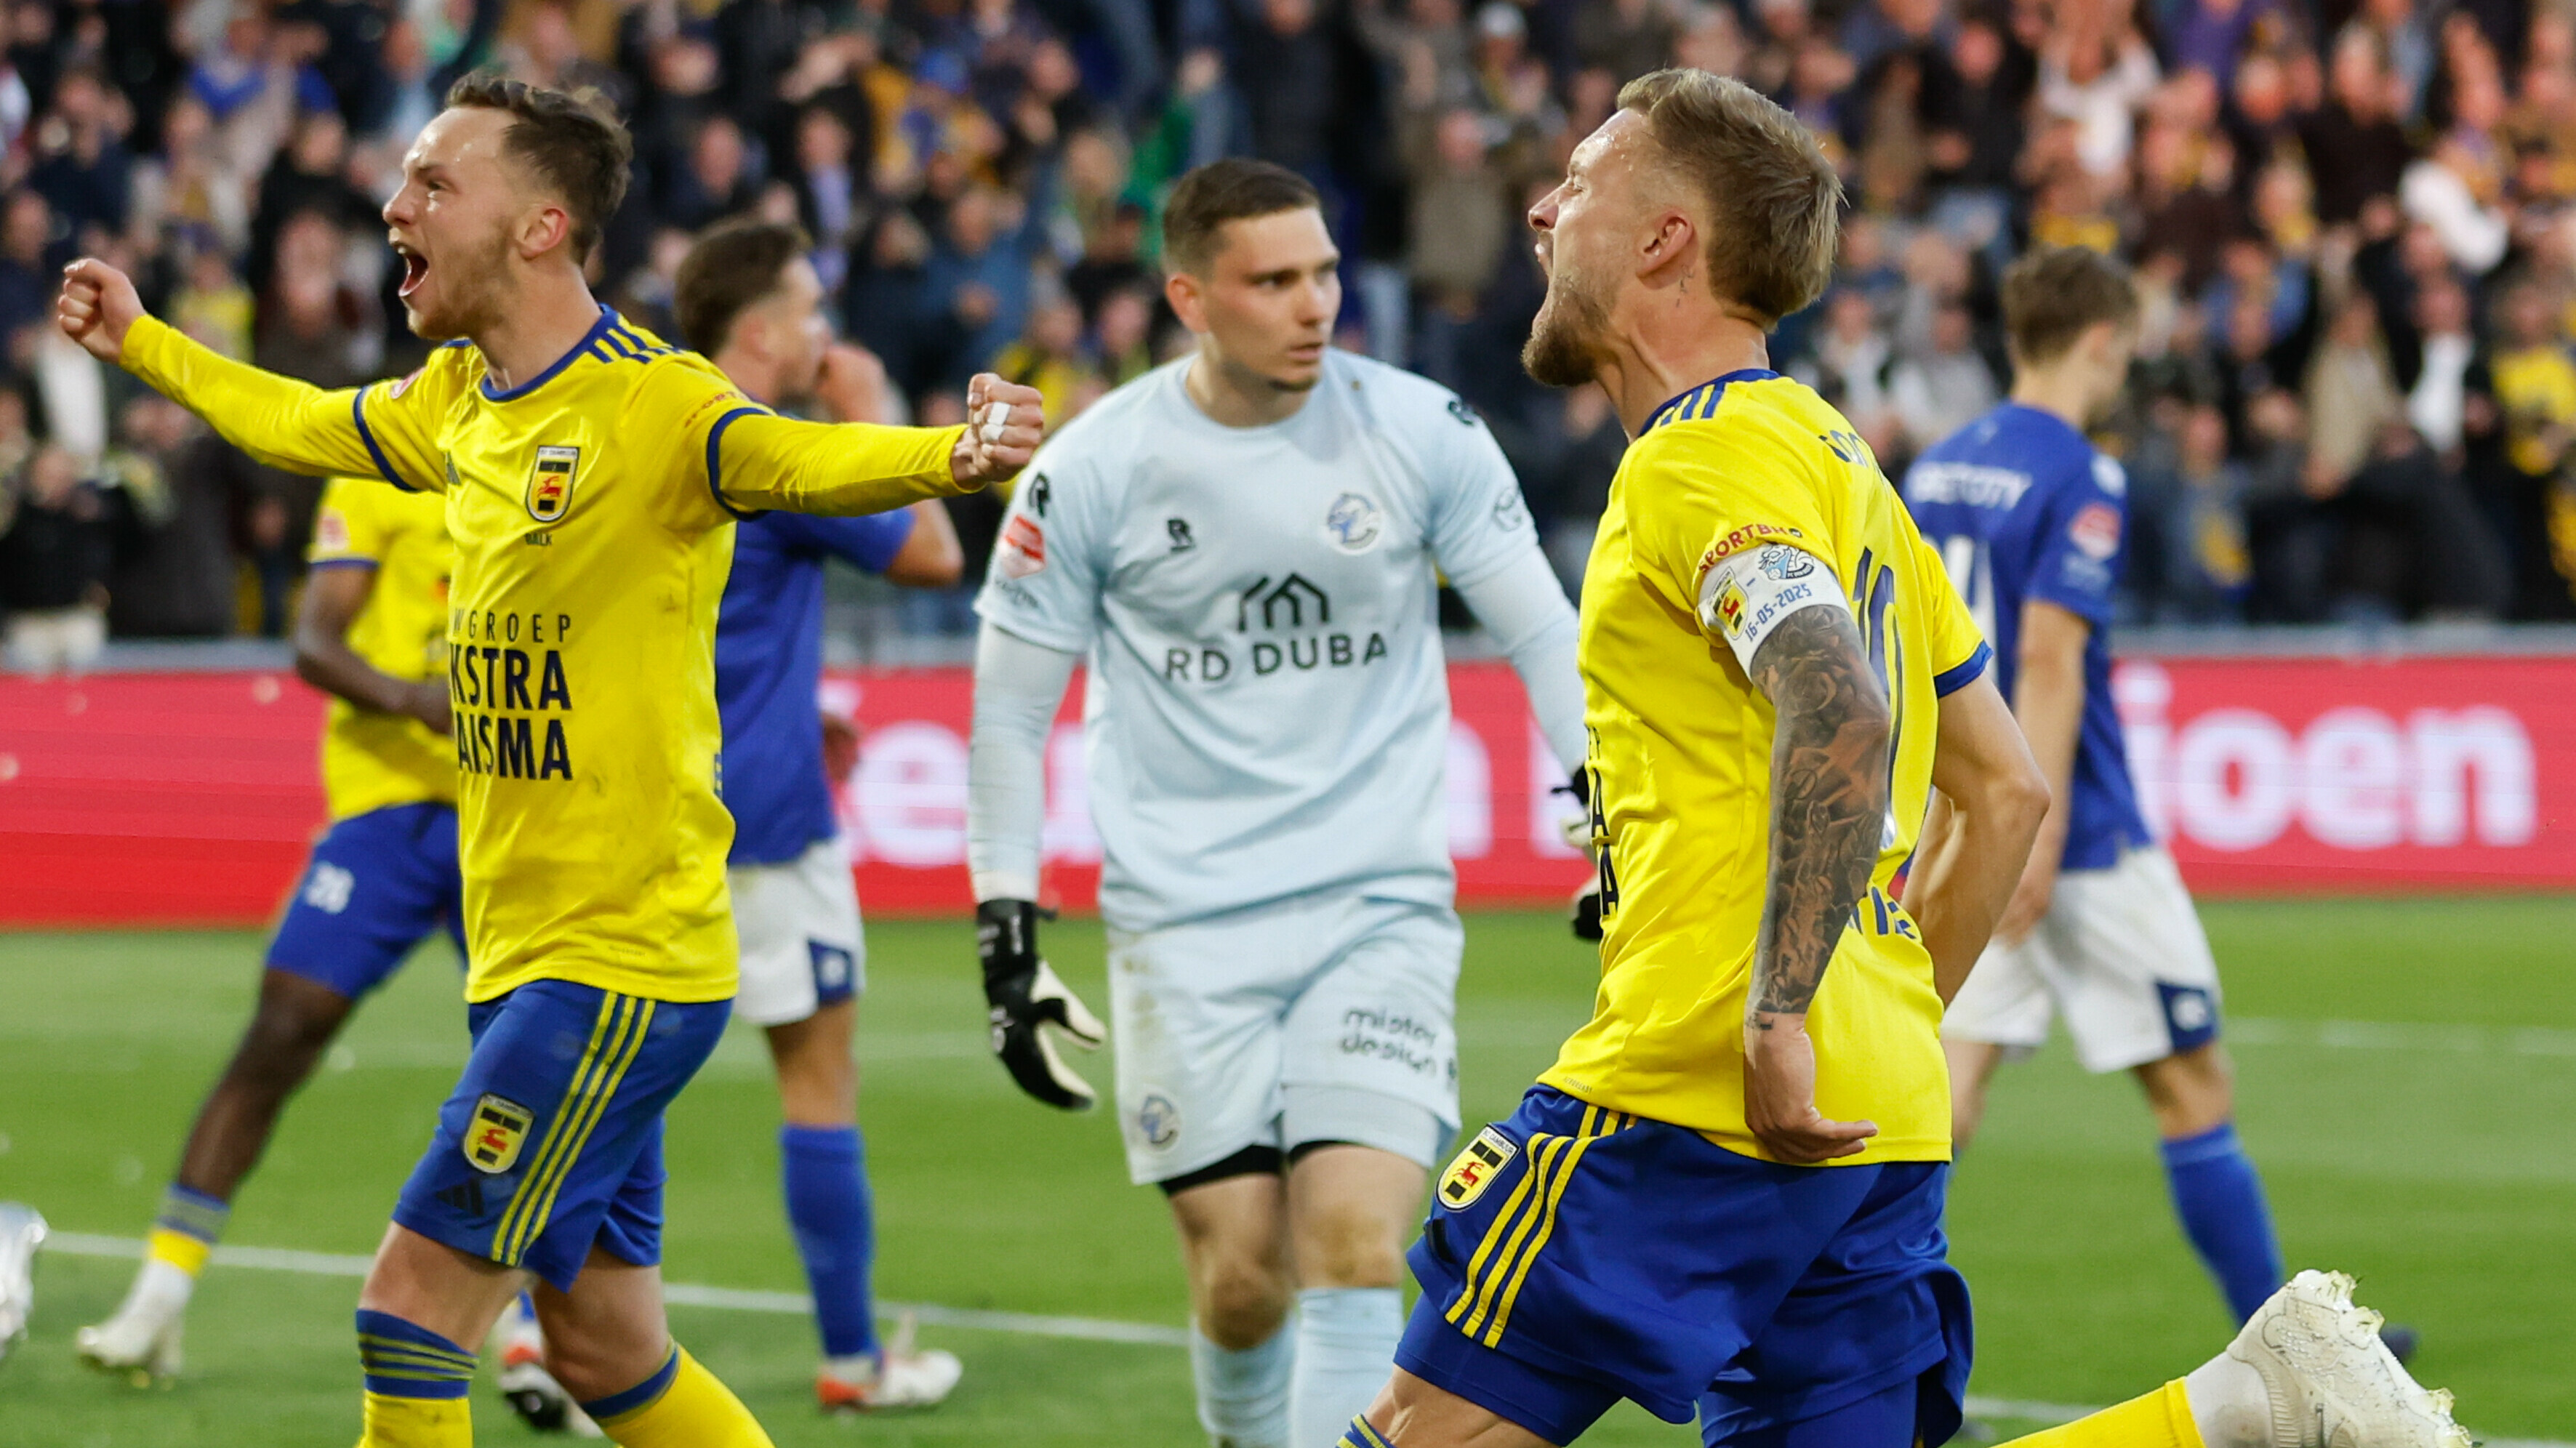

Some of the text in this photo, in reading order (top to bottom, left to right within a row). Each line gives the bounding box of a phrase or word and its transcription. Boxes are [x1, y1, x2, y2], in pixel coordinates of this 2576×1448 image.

[1744, 583, 1813, 643] 16-05-2025
[1165, 632, 1388, 681] RD DUBA
